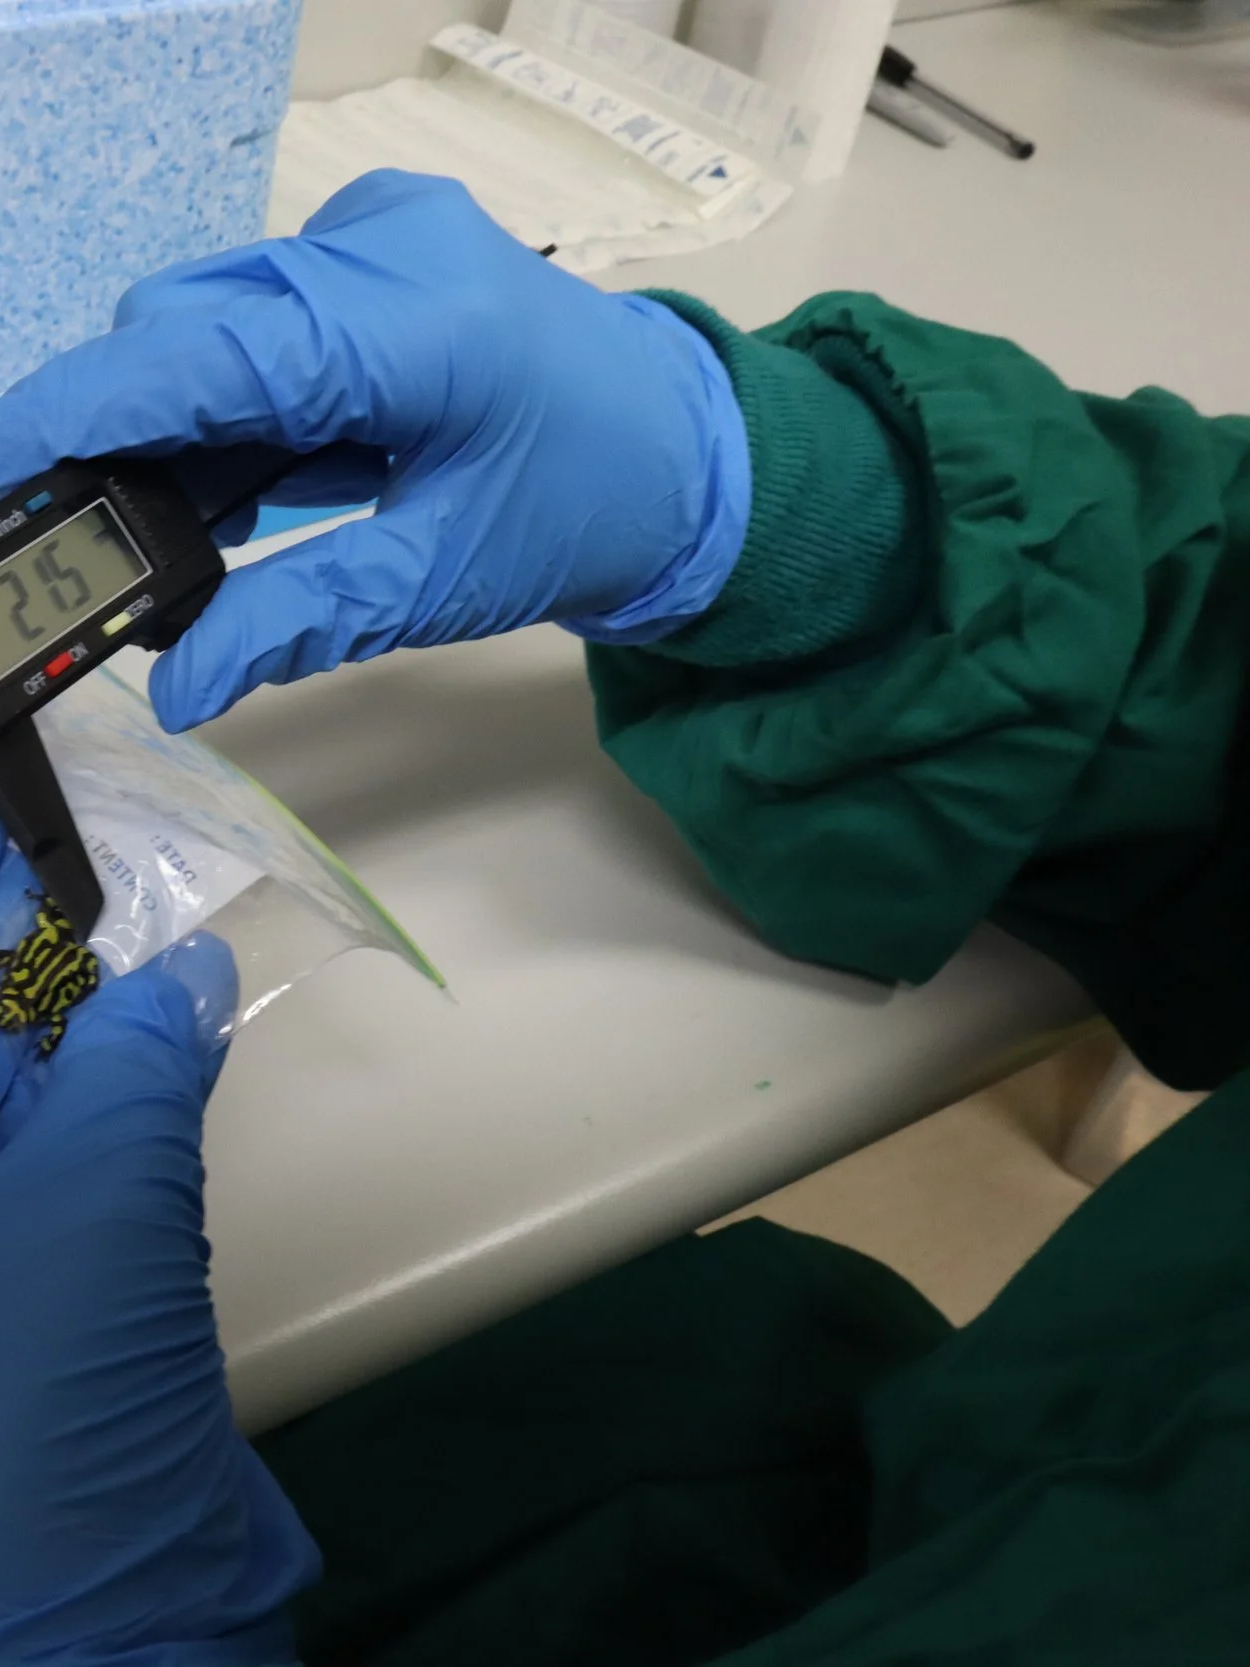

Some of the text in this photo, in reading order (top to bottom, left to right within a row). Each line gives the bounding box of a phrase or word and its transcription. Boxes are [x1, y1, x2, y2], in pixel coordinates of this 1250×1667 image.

[124, 594, 155, 621] ZERO
[23, 642, 90, 696] OFF ON
